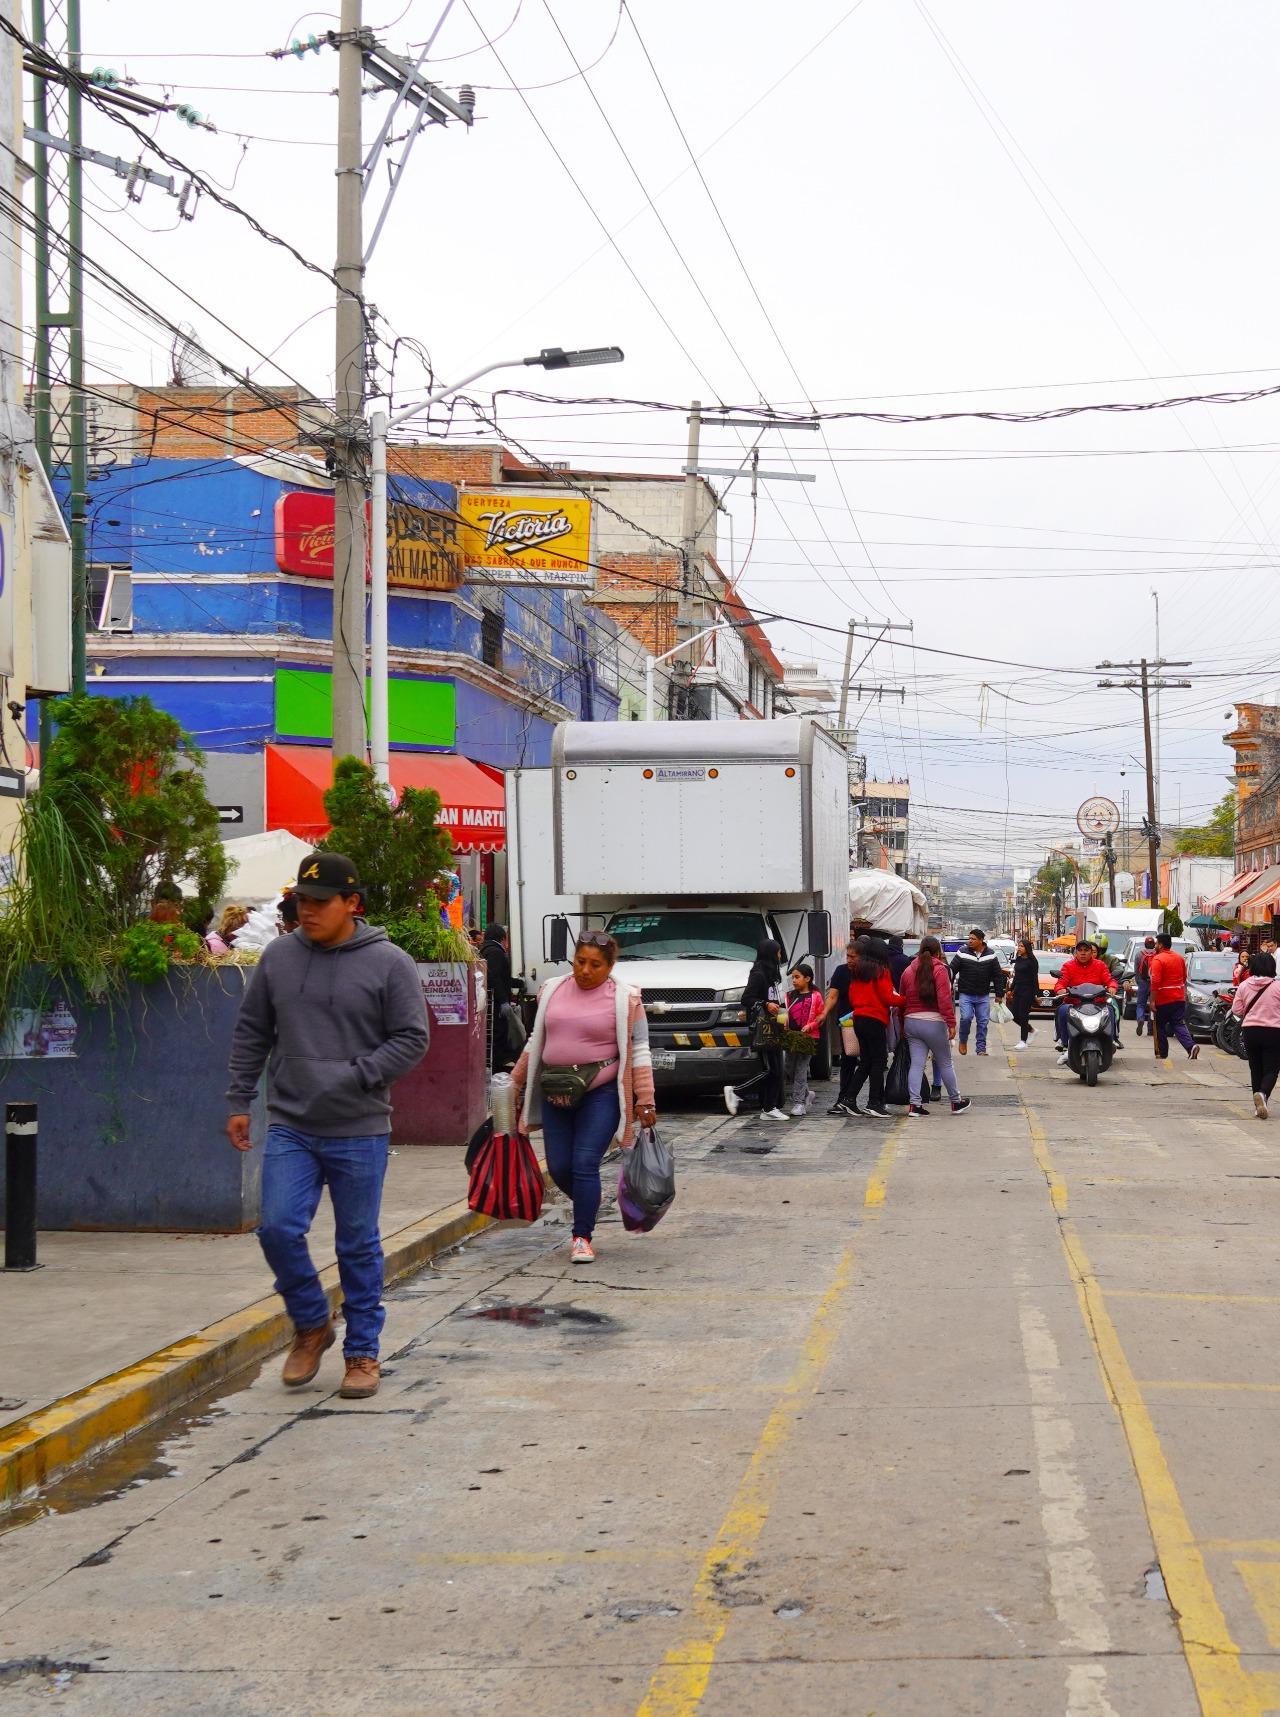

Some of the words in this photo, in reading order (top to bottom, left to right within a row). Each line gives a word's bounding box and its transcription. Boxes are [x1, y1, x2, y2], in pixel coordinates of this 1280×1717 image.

[467, 498, 512, 508] CERVEZA
[477, 508, 573, 556] Victoria
[387, 547, 405, 578] AN
[486, 555, 526, 567] SABROSA
[530, 557, 547, 568] QUE
[476, 569, 512, 580] SUPER
[516, 570, 539, 581] SAN
[543, 571, 587, 583] MARTIN
[658, 769, 705, 777] ALTAMIRANO
[462, 808, 506, 828] MARTI
[421, 979, 462, 988] LAUDIA
